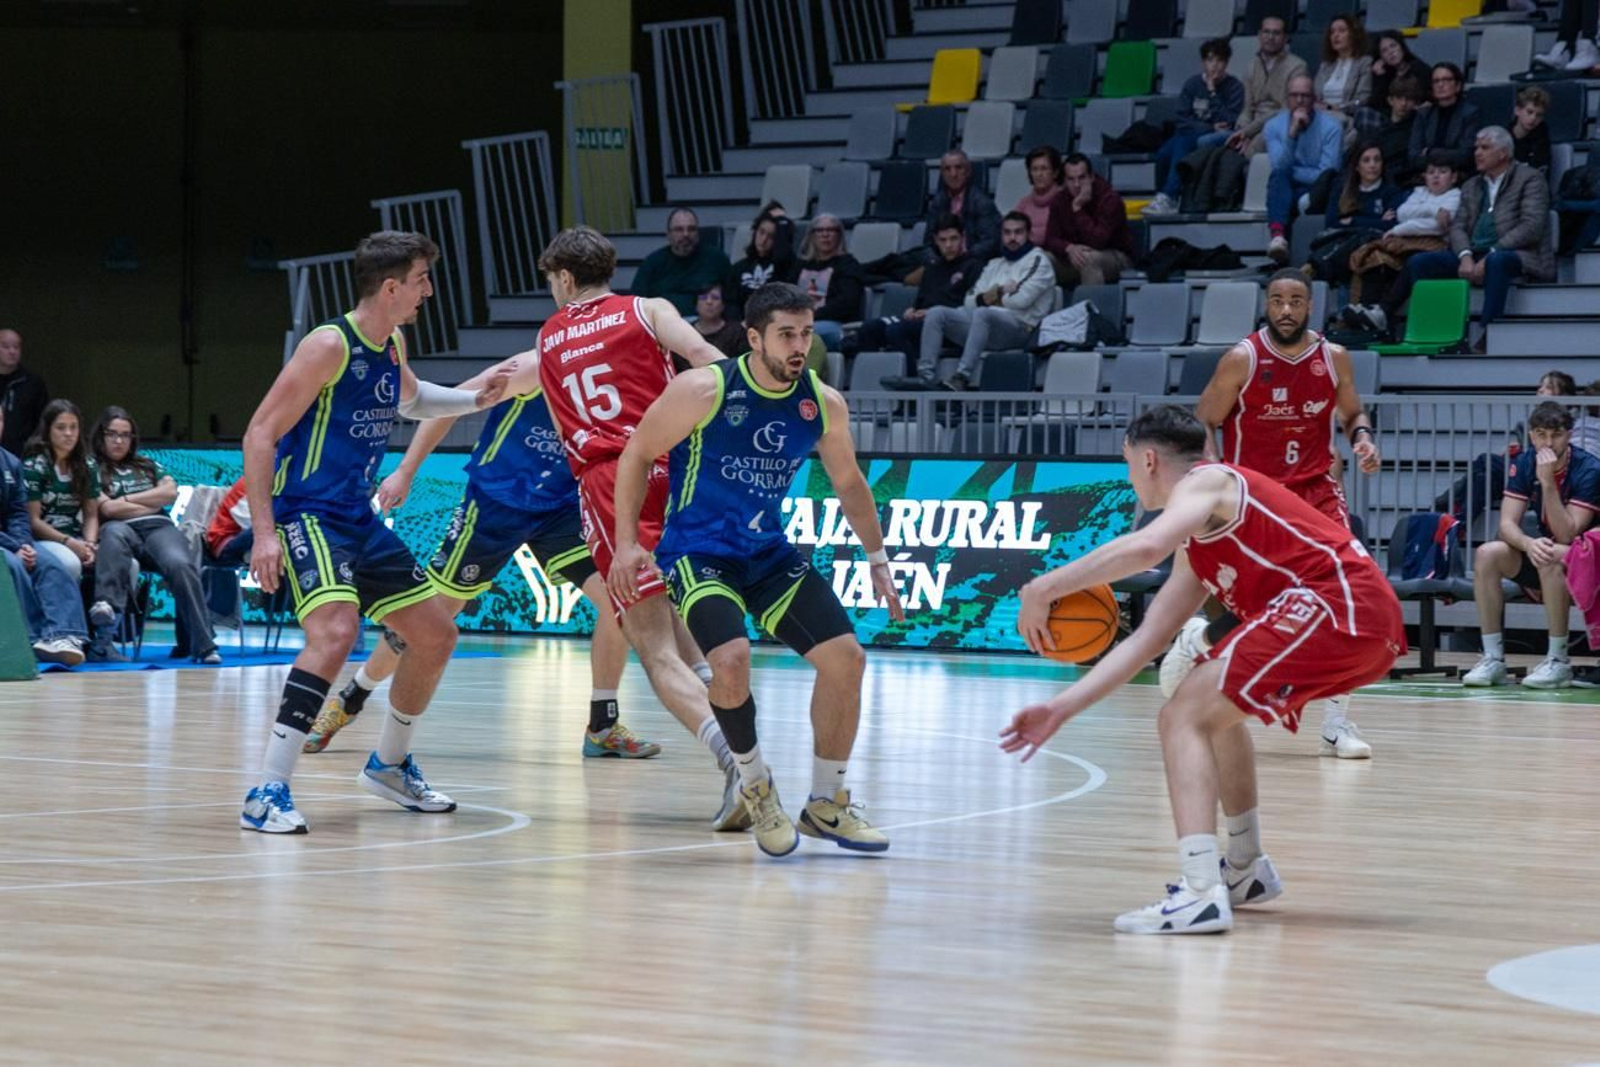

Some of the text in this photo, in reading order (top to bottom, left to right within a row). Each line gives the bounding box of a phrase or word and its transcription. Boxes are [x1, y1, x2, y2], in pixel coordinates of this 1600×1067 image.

[543, 310, 627, 353] JAVI MARTÍNEZ
[560, 342, 605, 363] Blanca
[561, 363, 622, 425] 15
[720, 454, 787, 471] CASTILLO
[1285, 440, 1300, 465] 6
[884, 499, 1051, 549] RURAL
